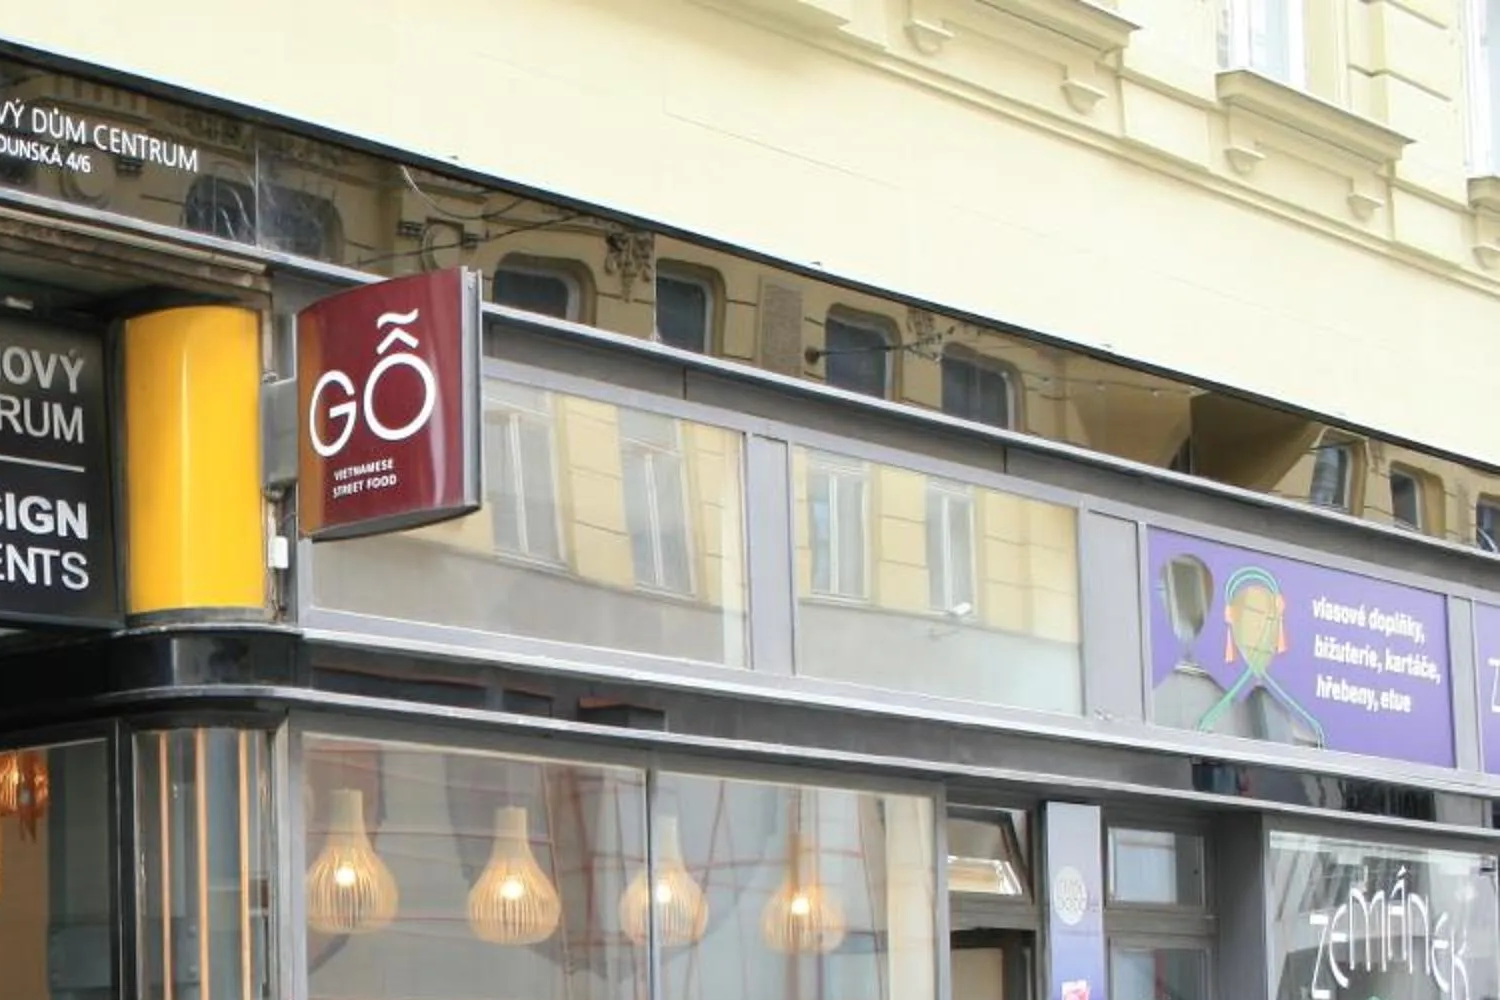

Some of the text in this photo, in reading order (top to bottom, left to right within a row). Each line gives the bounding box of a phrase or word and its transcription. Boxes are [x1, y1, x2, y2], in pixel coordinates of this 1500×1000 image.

[31, 107, 86, 145] DŮM
[93, 123, 198, 173] CENTRUM
[65, 151, 92, 174] 4/6
[333, 458, 394, 481] VIETNAMESE
[333, 473, 397, 499] STREET FOOD
[1312, 596, 1366, 627] vlasové
[1316, 673, 1379, 712] hřebeny,
